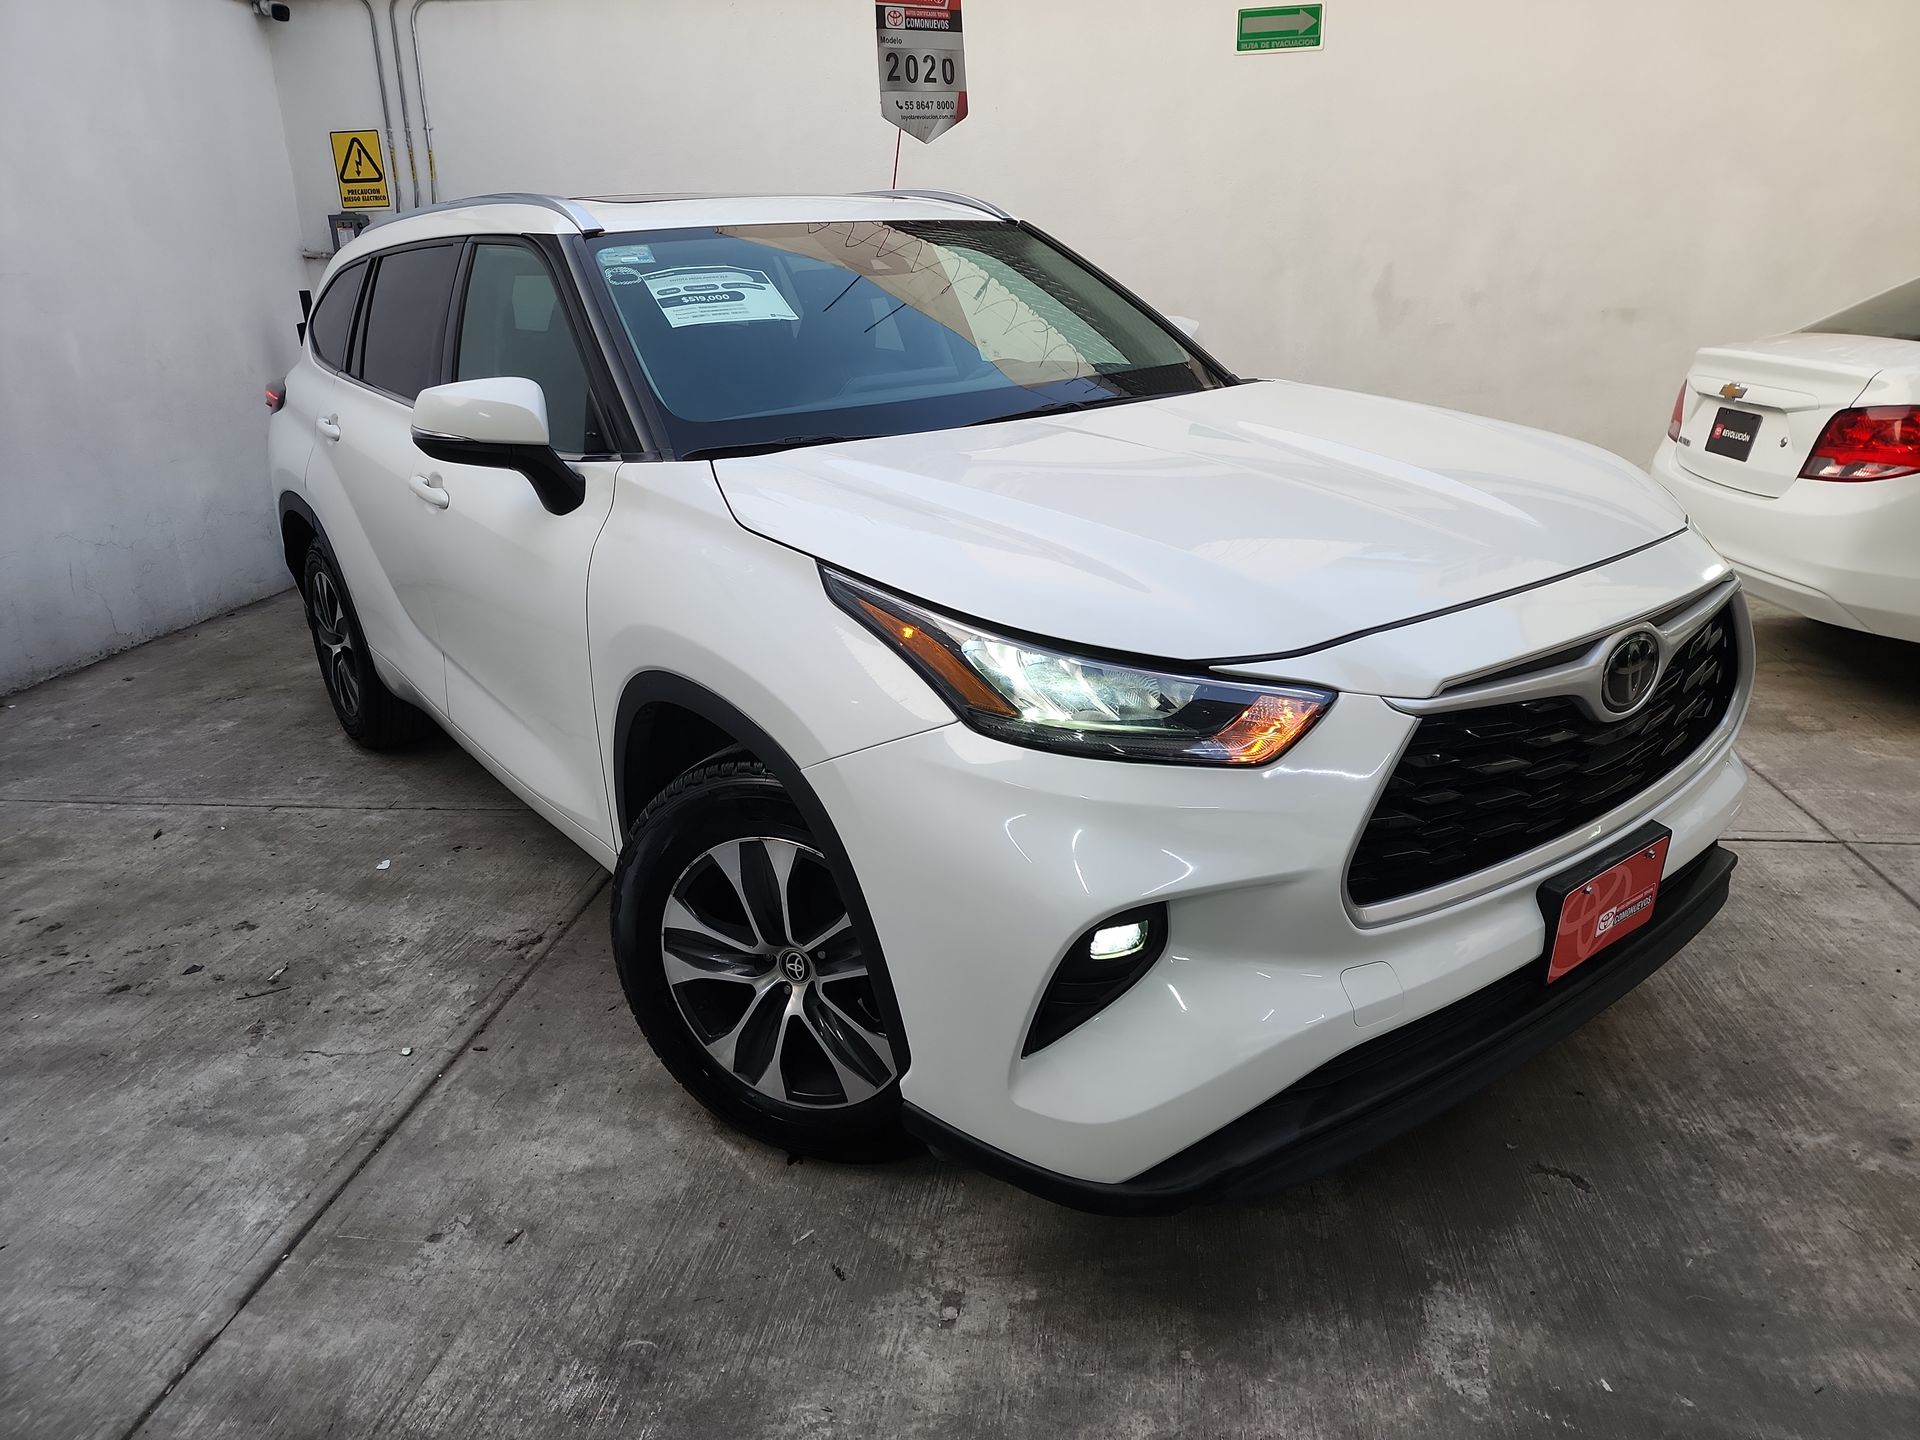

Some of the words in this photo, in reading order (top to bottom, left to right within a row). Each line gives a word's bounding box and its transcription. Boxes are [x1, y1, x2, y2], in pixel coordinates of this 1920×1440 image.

[905, 17, 950, 30] COMONUEVOS
[880, 36, 903, 45] Modelo
[1271, 38, 1317, 48] EVACUACION
[885, 52, 955, 85] 2020
[904, 100, 914, 110] 55
[915, 100, 934, 110] 8647
[936, 100, 955, 110] 8000
[361, 194, 387, 202] ELECTRICO
[681, 293, 730, 304] $519,000
[1722, 428, 1751, 443] REVOLUCIÓN
[1613, 895, 1652, 926] COMONUEVOS
